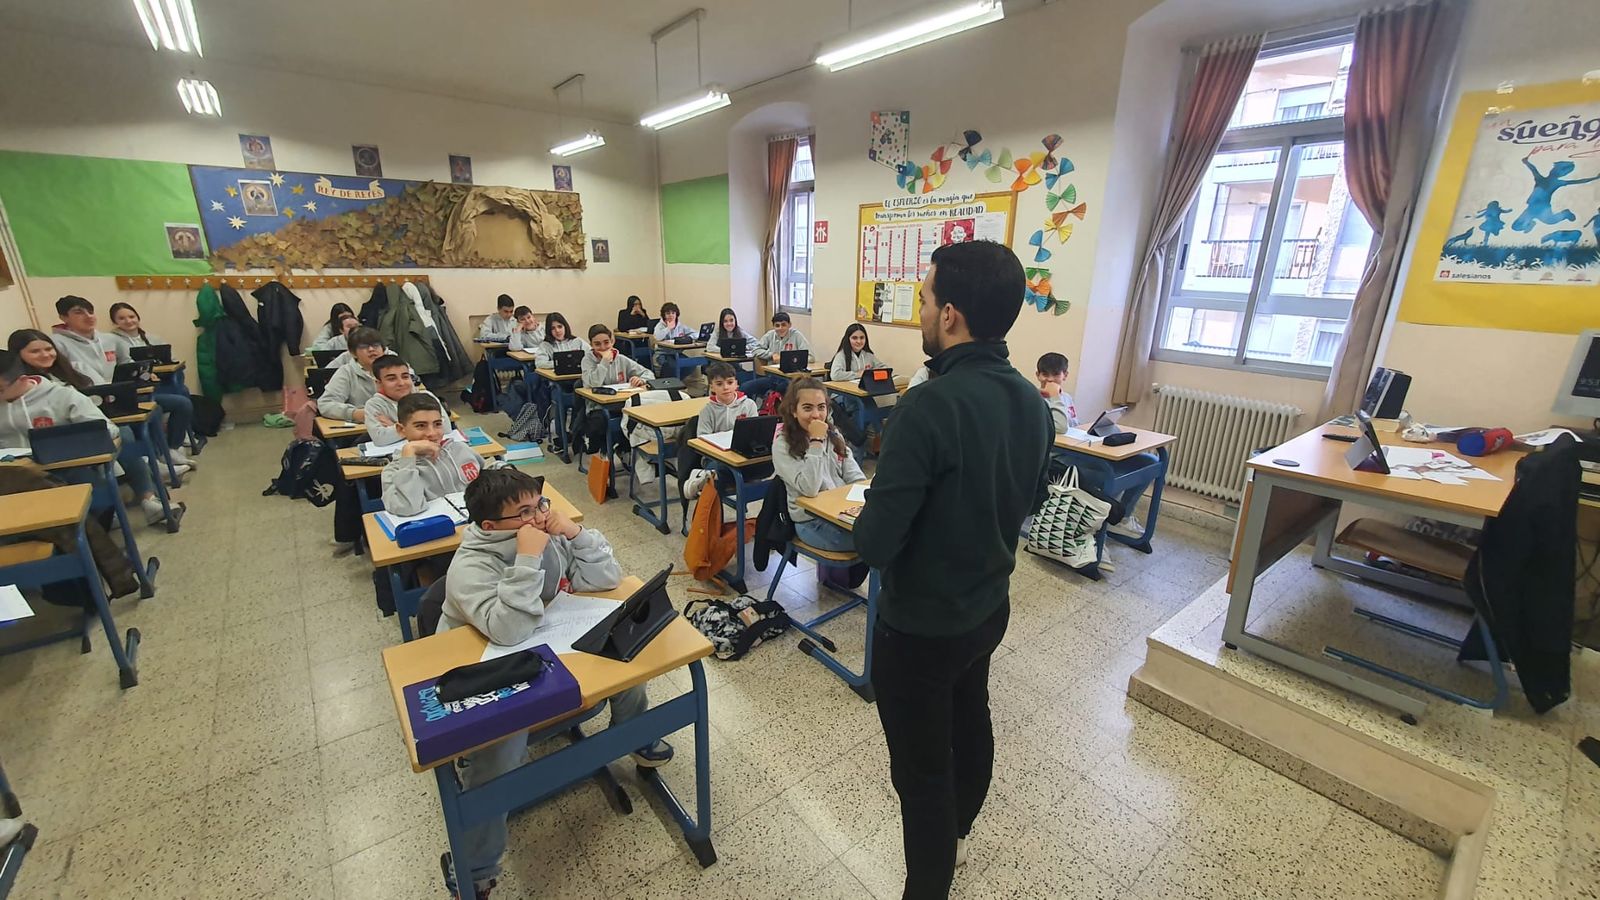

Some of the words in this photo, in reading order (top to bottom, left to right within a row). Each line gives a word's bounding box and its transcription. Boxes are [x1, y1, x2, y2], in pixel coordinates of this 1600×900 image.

[317, 186, 336, 195] REY
[892, 196, 922, 207] ESFUERZO
[938, 193, 960, 204] magia
[961, 194, 973, 203] que
[949, 205, 984, 217] REALIDAD
[1451, 272, 1491, 280] salesianos
